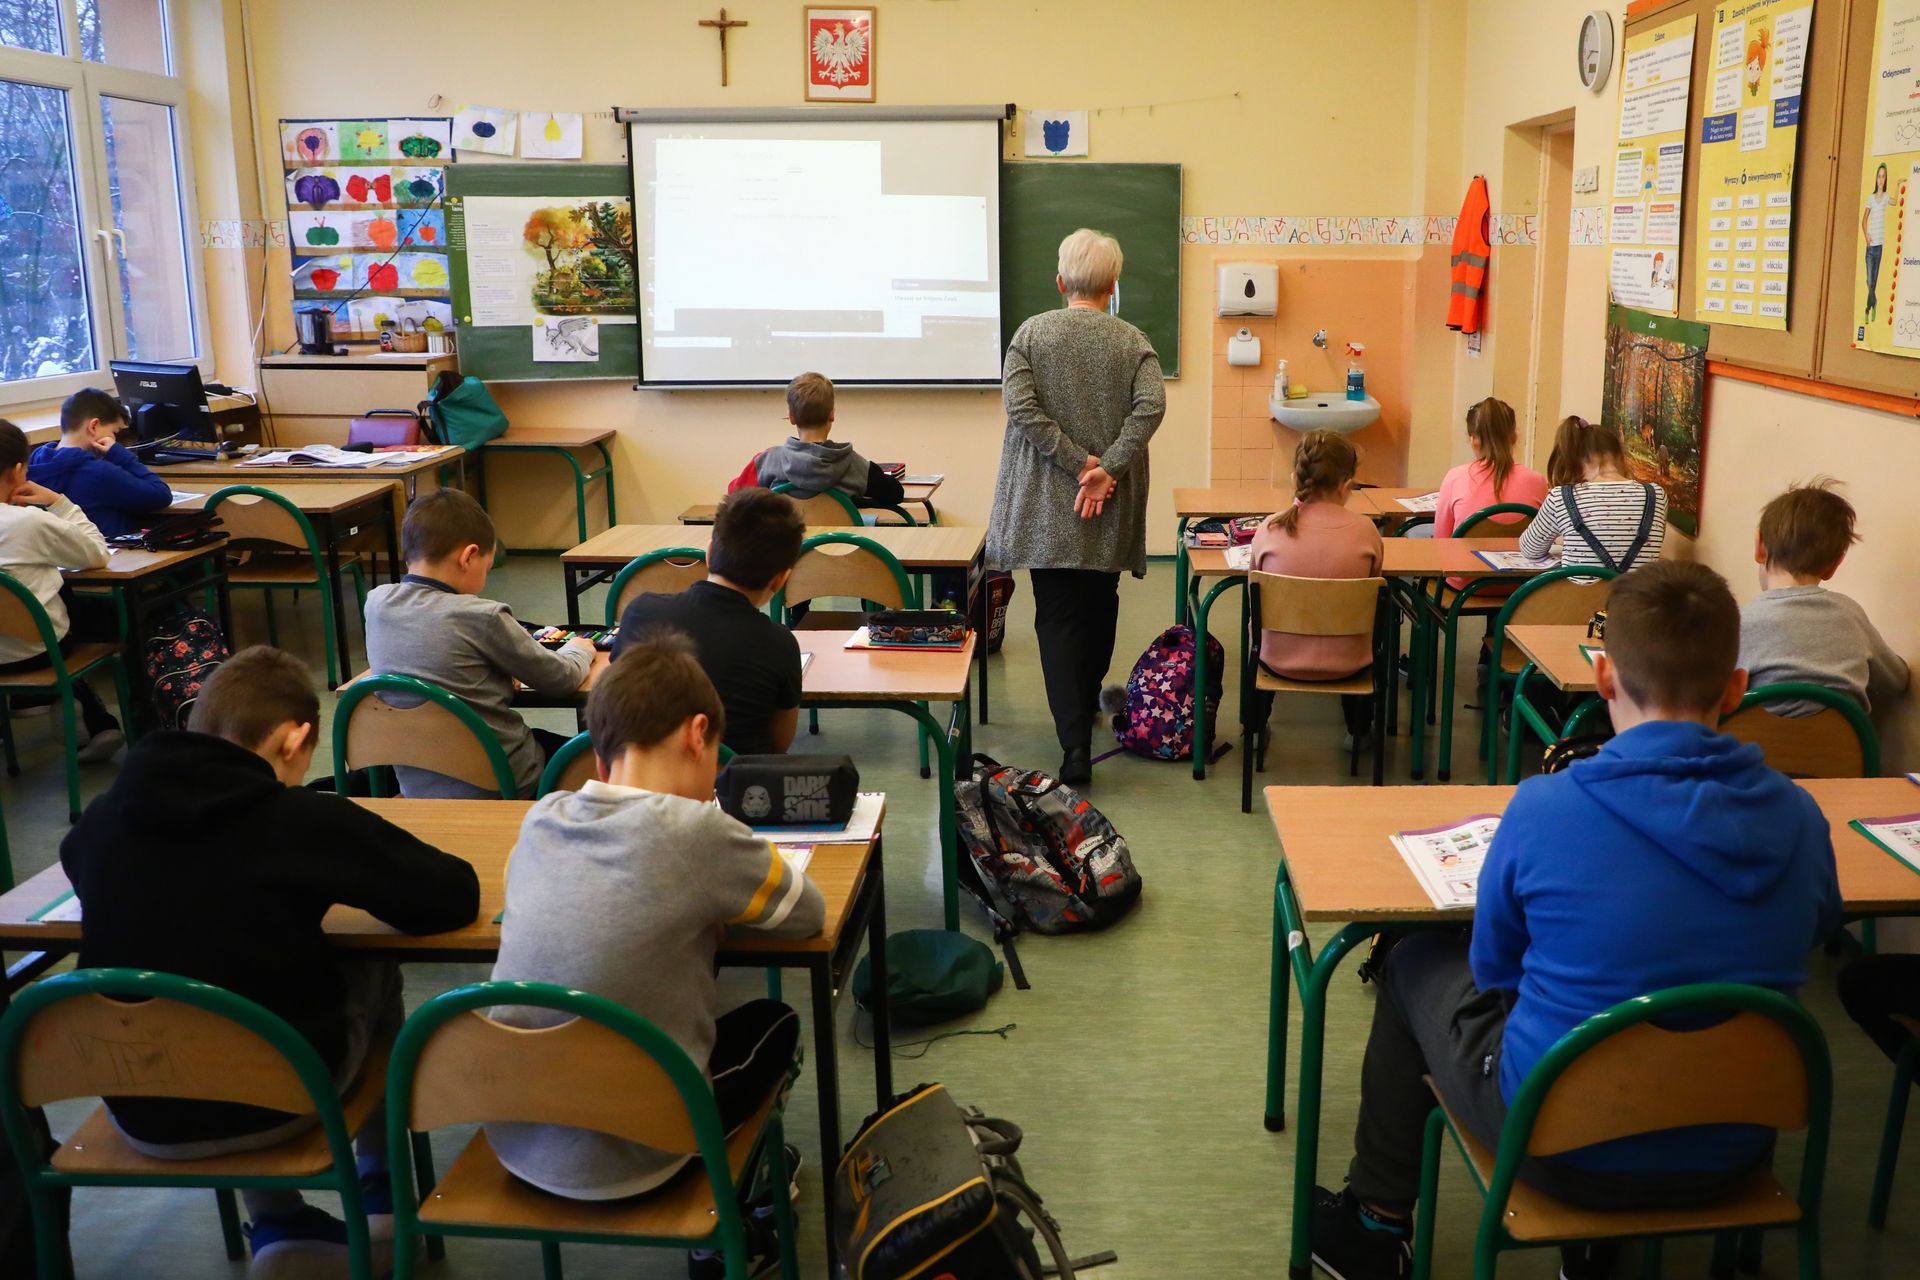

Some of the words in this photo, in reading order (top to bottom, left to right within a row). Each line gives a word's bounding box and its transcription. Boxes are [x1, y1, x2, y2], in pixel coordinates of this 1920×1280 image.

[140, 380, 157, 388] ASUS
[783, 775, 831, 798] DARK
[782, 796, 831, 822] SIDE
